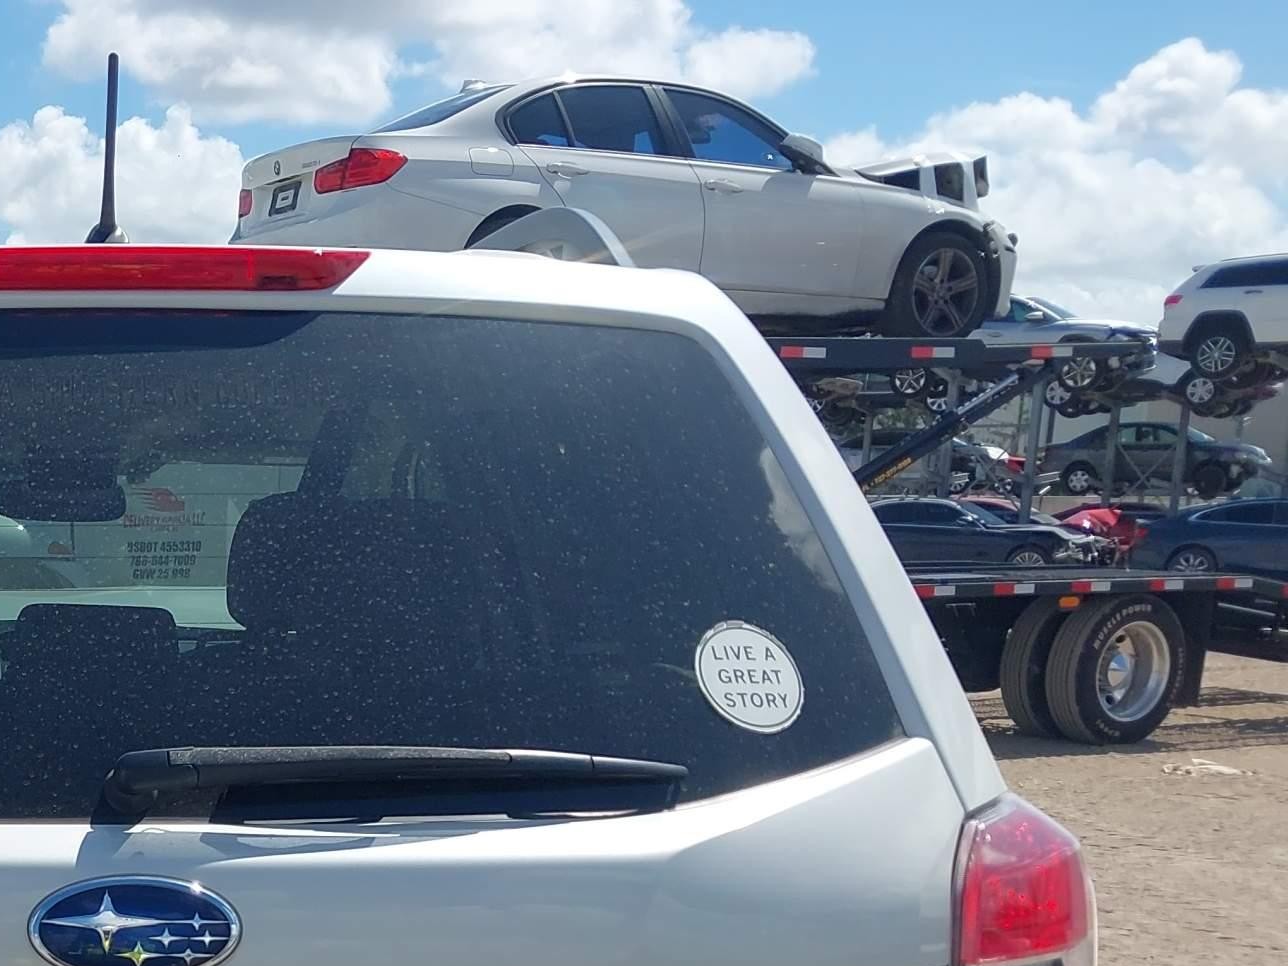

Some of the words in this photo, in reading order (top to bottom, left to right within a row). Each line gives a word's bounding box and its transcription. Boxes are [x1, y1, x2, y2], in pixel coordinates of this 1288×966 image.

[711, 645, 757, 661] LIVE
[764, 646, 777, 661] A
[718, 668, 782, 685] GREAT
[724, 692, 788, 708] STORY
